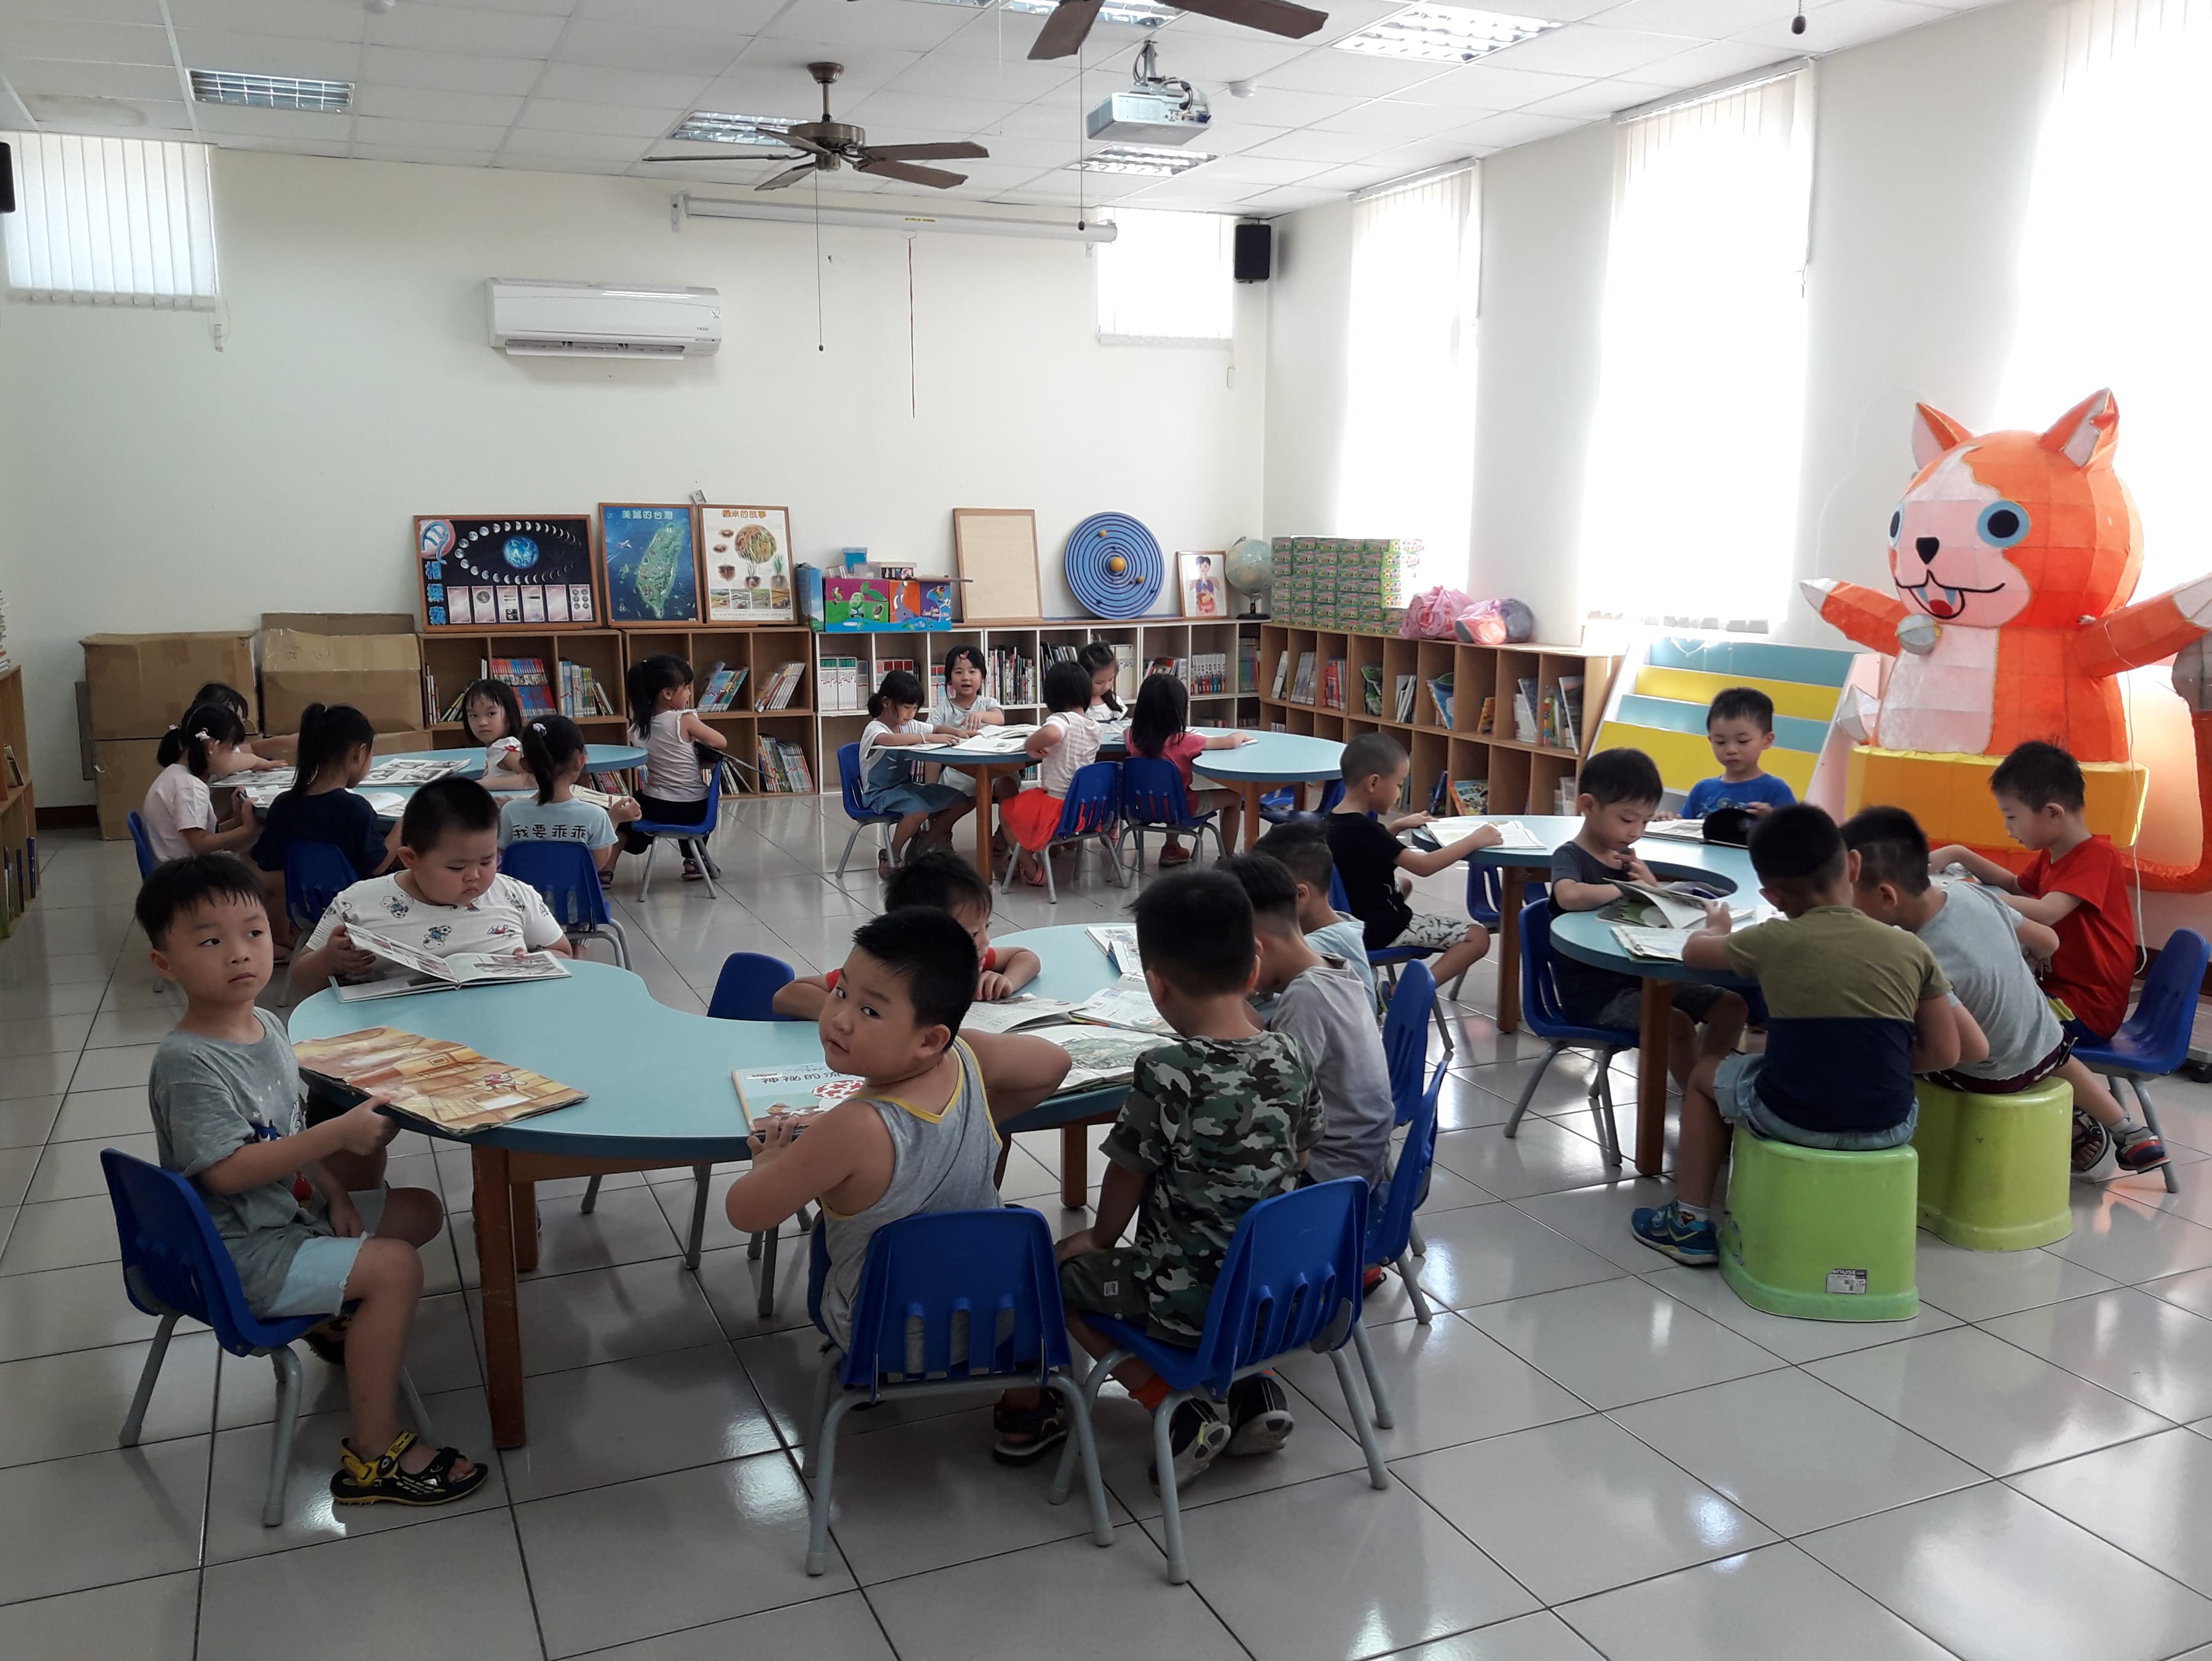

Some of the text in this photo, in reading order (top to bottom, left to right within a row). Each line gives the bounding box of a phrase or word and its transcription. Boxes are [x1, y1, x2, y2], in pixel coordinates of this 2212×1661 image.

[621, 510, 673, 520] 美麗的台灣
[512, 824, 587, 839] 我要乖乖
